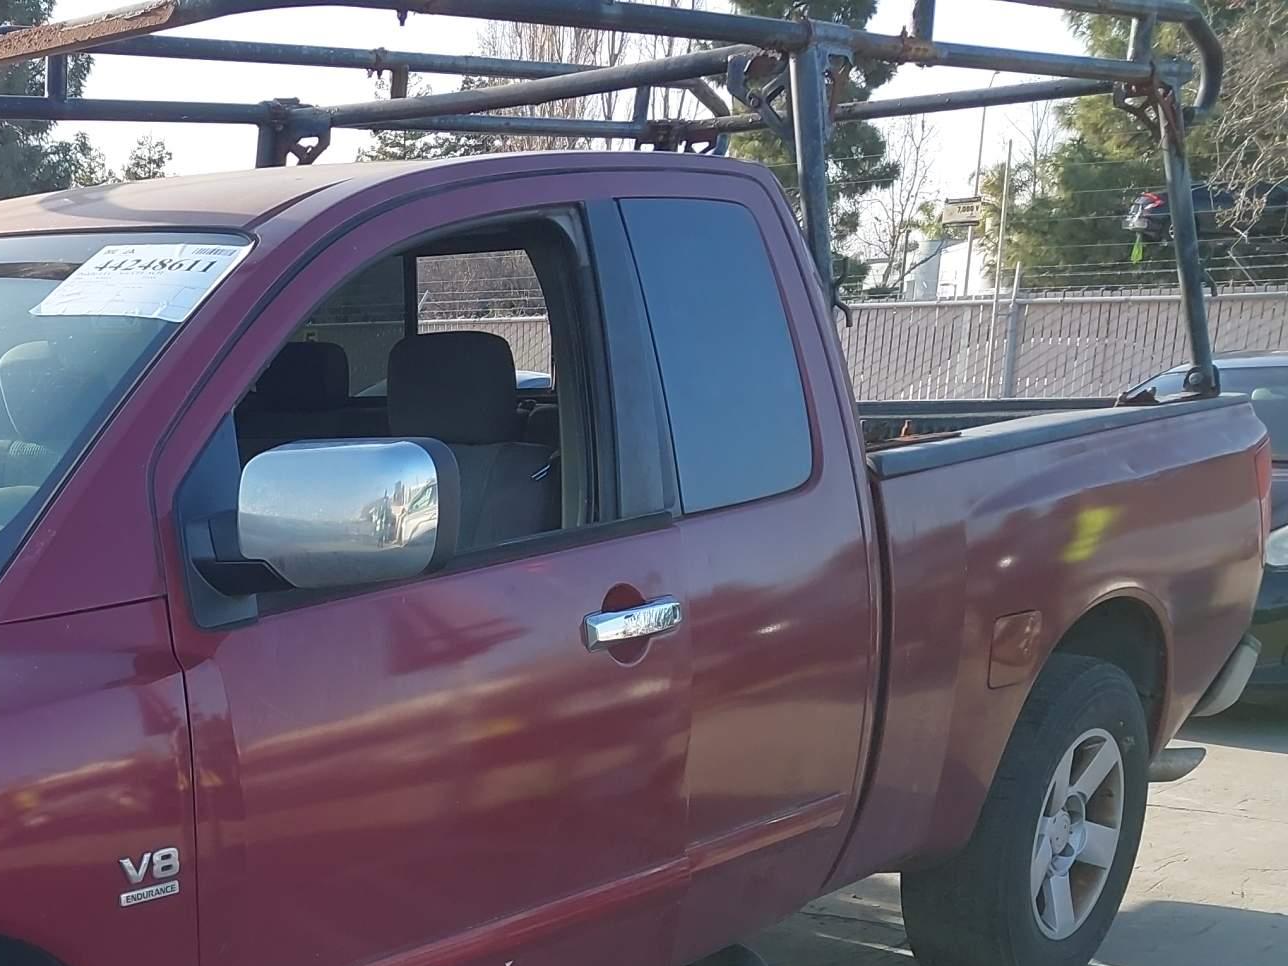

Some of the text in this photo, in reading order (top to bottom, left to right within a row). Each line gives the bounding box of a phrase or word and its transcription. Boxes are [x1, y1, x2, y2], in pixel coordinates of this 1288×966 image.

[94, 257, 218, 273] 44248611
[119, 847, 180, 885] V8
[125, 884, 177, 904] ENDURANCE
